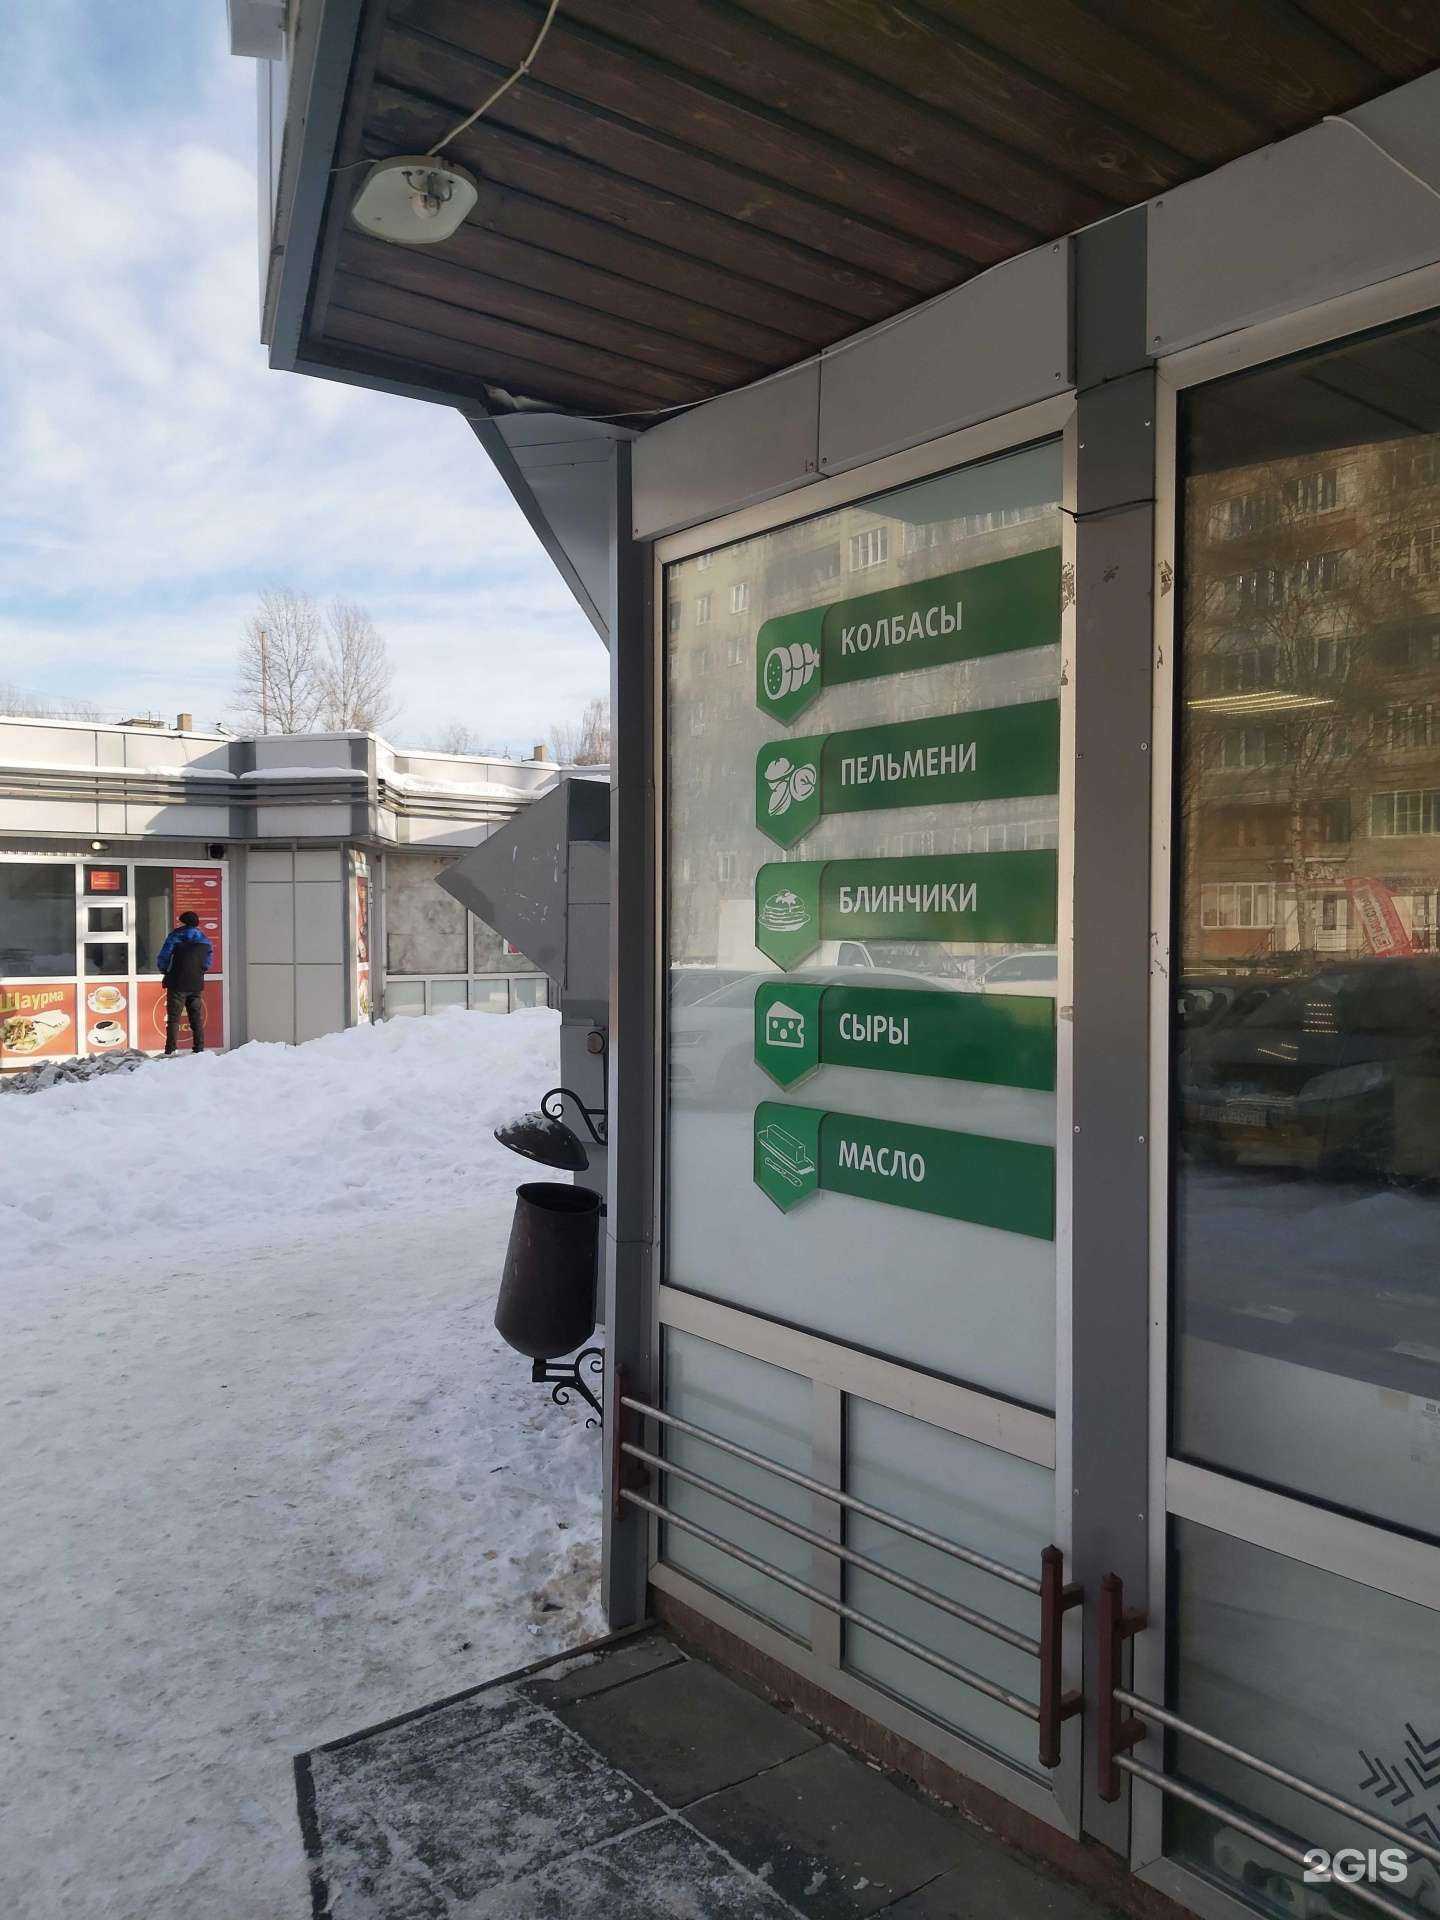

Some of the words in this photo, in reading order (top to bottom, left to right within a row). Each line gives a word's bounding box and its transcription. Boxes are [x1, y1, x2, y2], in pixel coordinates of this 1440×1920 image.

[841, 601, 963, 656] КОЛБАСЫ
[841, 742, 977, 786] ПЕЛЬМЕНИ
[840, 883, 978, 914] БЛИНЧИКИ
[840, 1014, 909, 1045] СЫРЫ
[839, 1141, 925, 1182] МАСЛО
